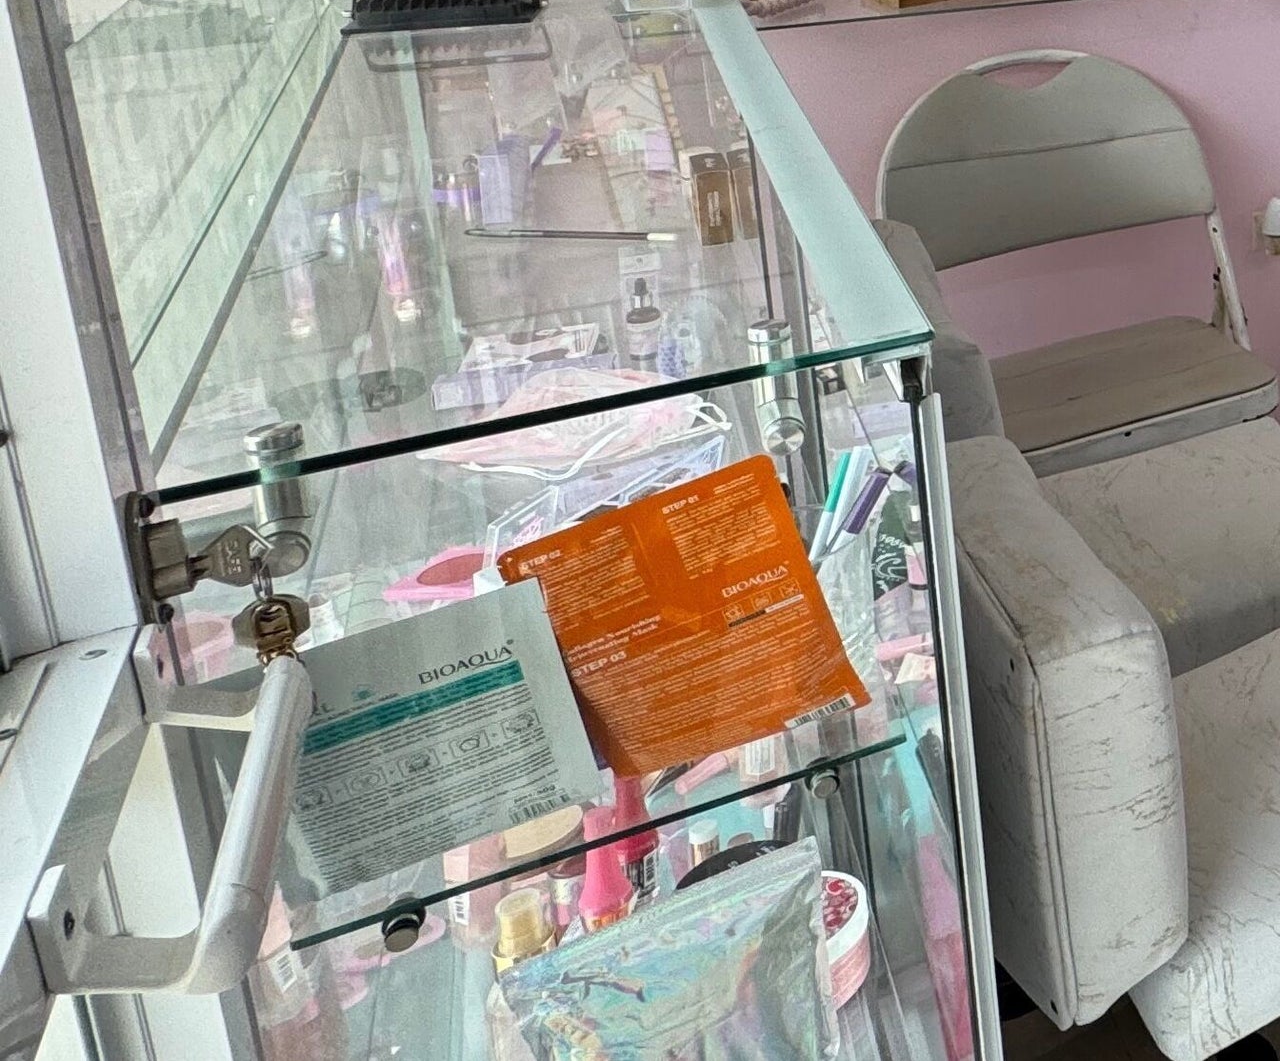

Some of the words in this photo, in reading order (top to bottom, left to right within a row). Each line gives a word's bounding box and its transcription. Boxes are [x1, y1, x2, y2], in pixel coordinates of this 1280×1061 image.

[661, 499, 687, 515] STEP
[721, 565, 789, 598] BIOAQUA
[418, 644, 514, 685] BIOAQUA
[571, 658, 608, 677] STEP
